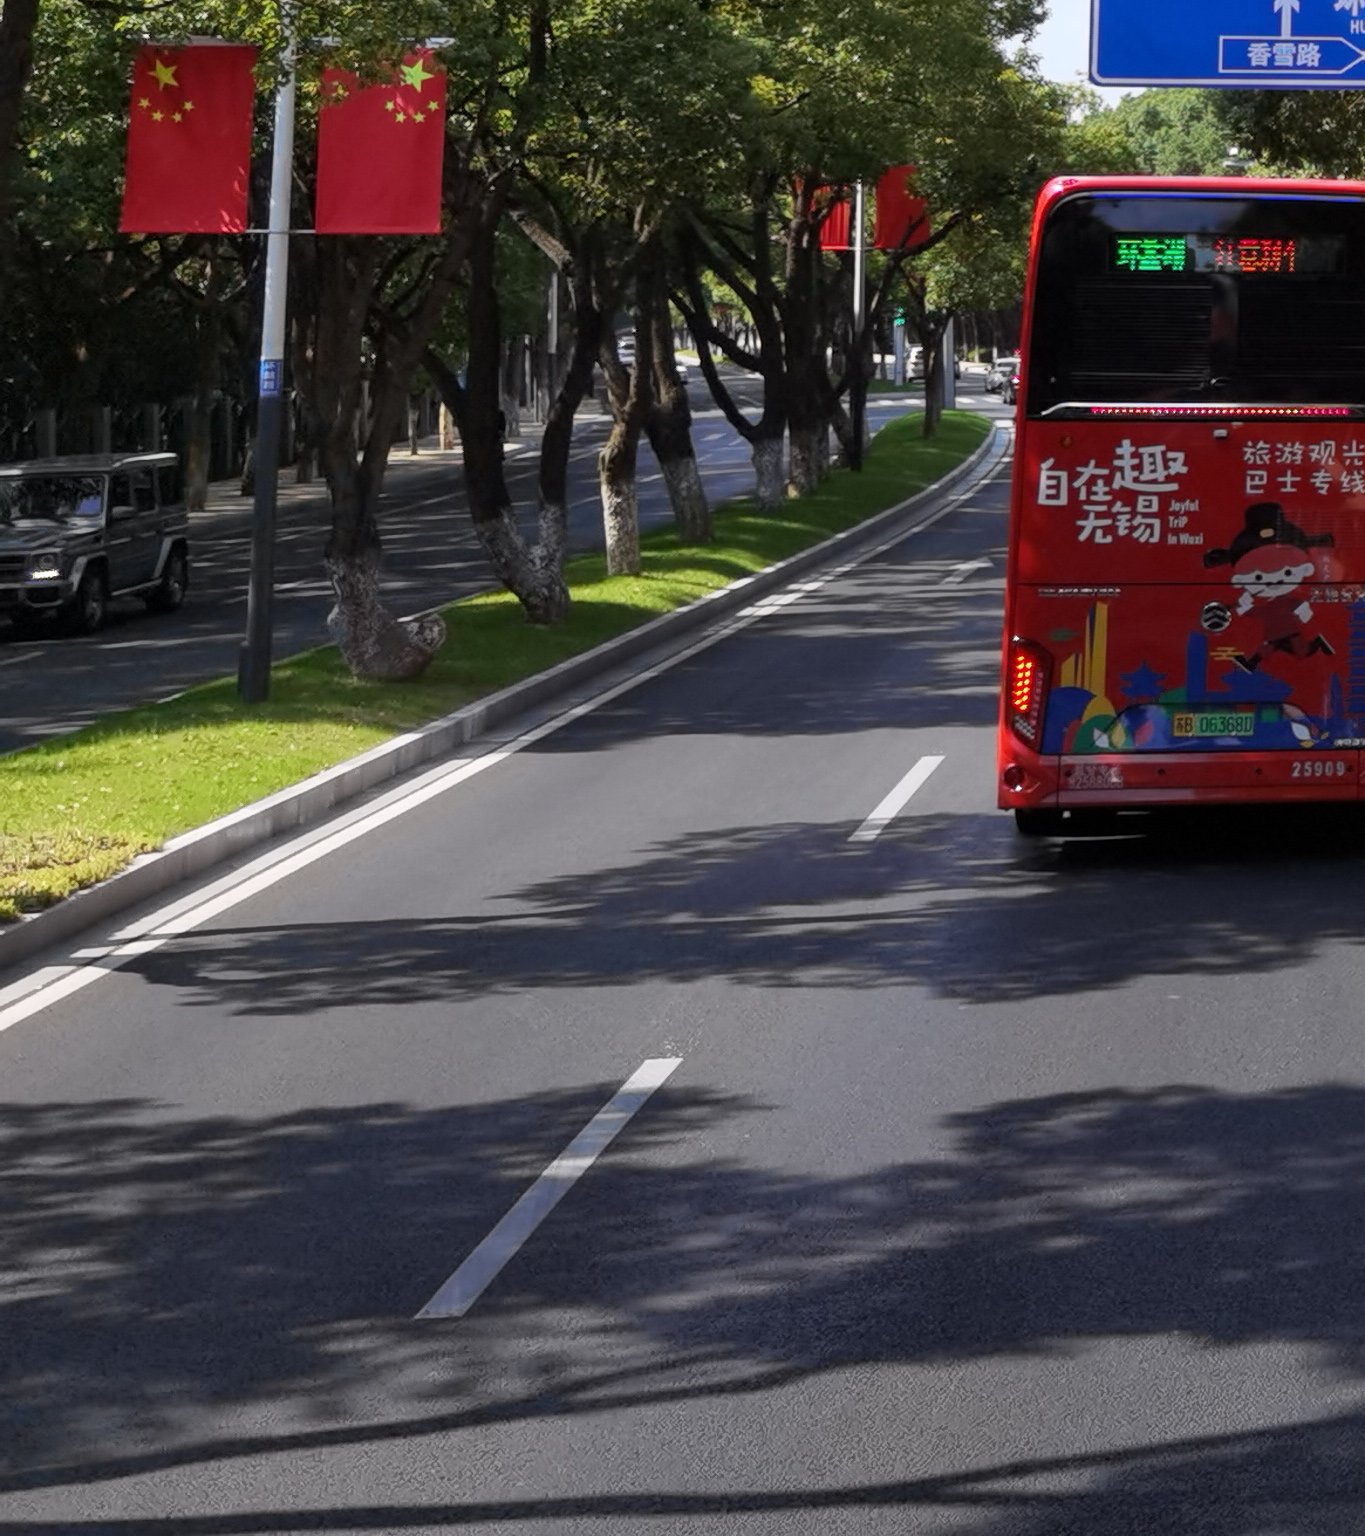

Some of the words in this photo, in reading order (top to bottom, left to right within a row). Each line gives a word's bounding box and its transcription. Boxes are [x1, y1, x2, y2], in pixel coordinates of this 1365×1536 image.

[1247, 42, 1321, 68] 香雪路
[1037, 438, 1189, 506] 自在趣
[1243, 440, 1365, 466] 旅游观光
[1075, 494, 1162, 544] 无锡
